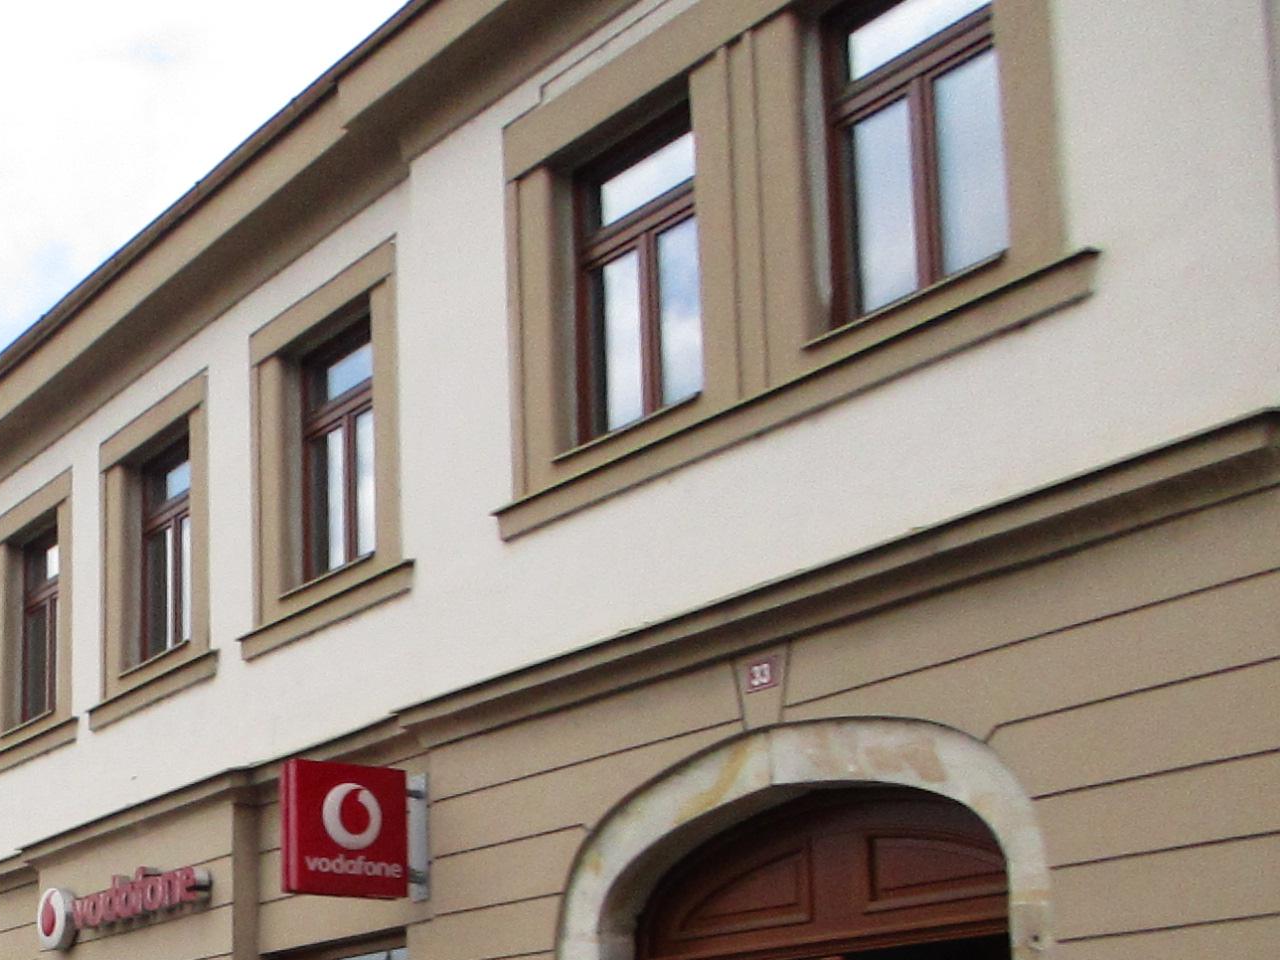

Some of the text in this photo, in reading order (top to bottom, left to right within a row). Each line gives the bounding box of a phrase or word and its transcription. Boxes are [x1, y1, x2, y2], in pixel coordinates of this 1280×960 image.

[751, 663, 770, 687] 33
[304, 855, 404, 879] vodafone
[74, 866, 197, 929] vodafone
